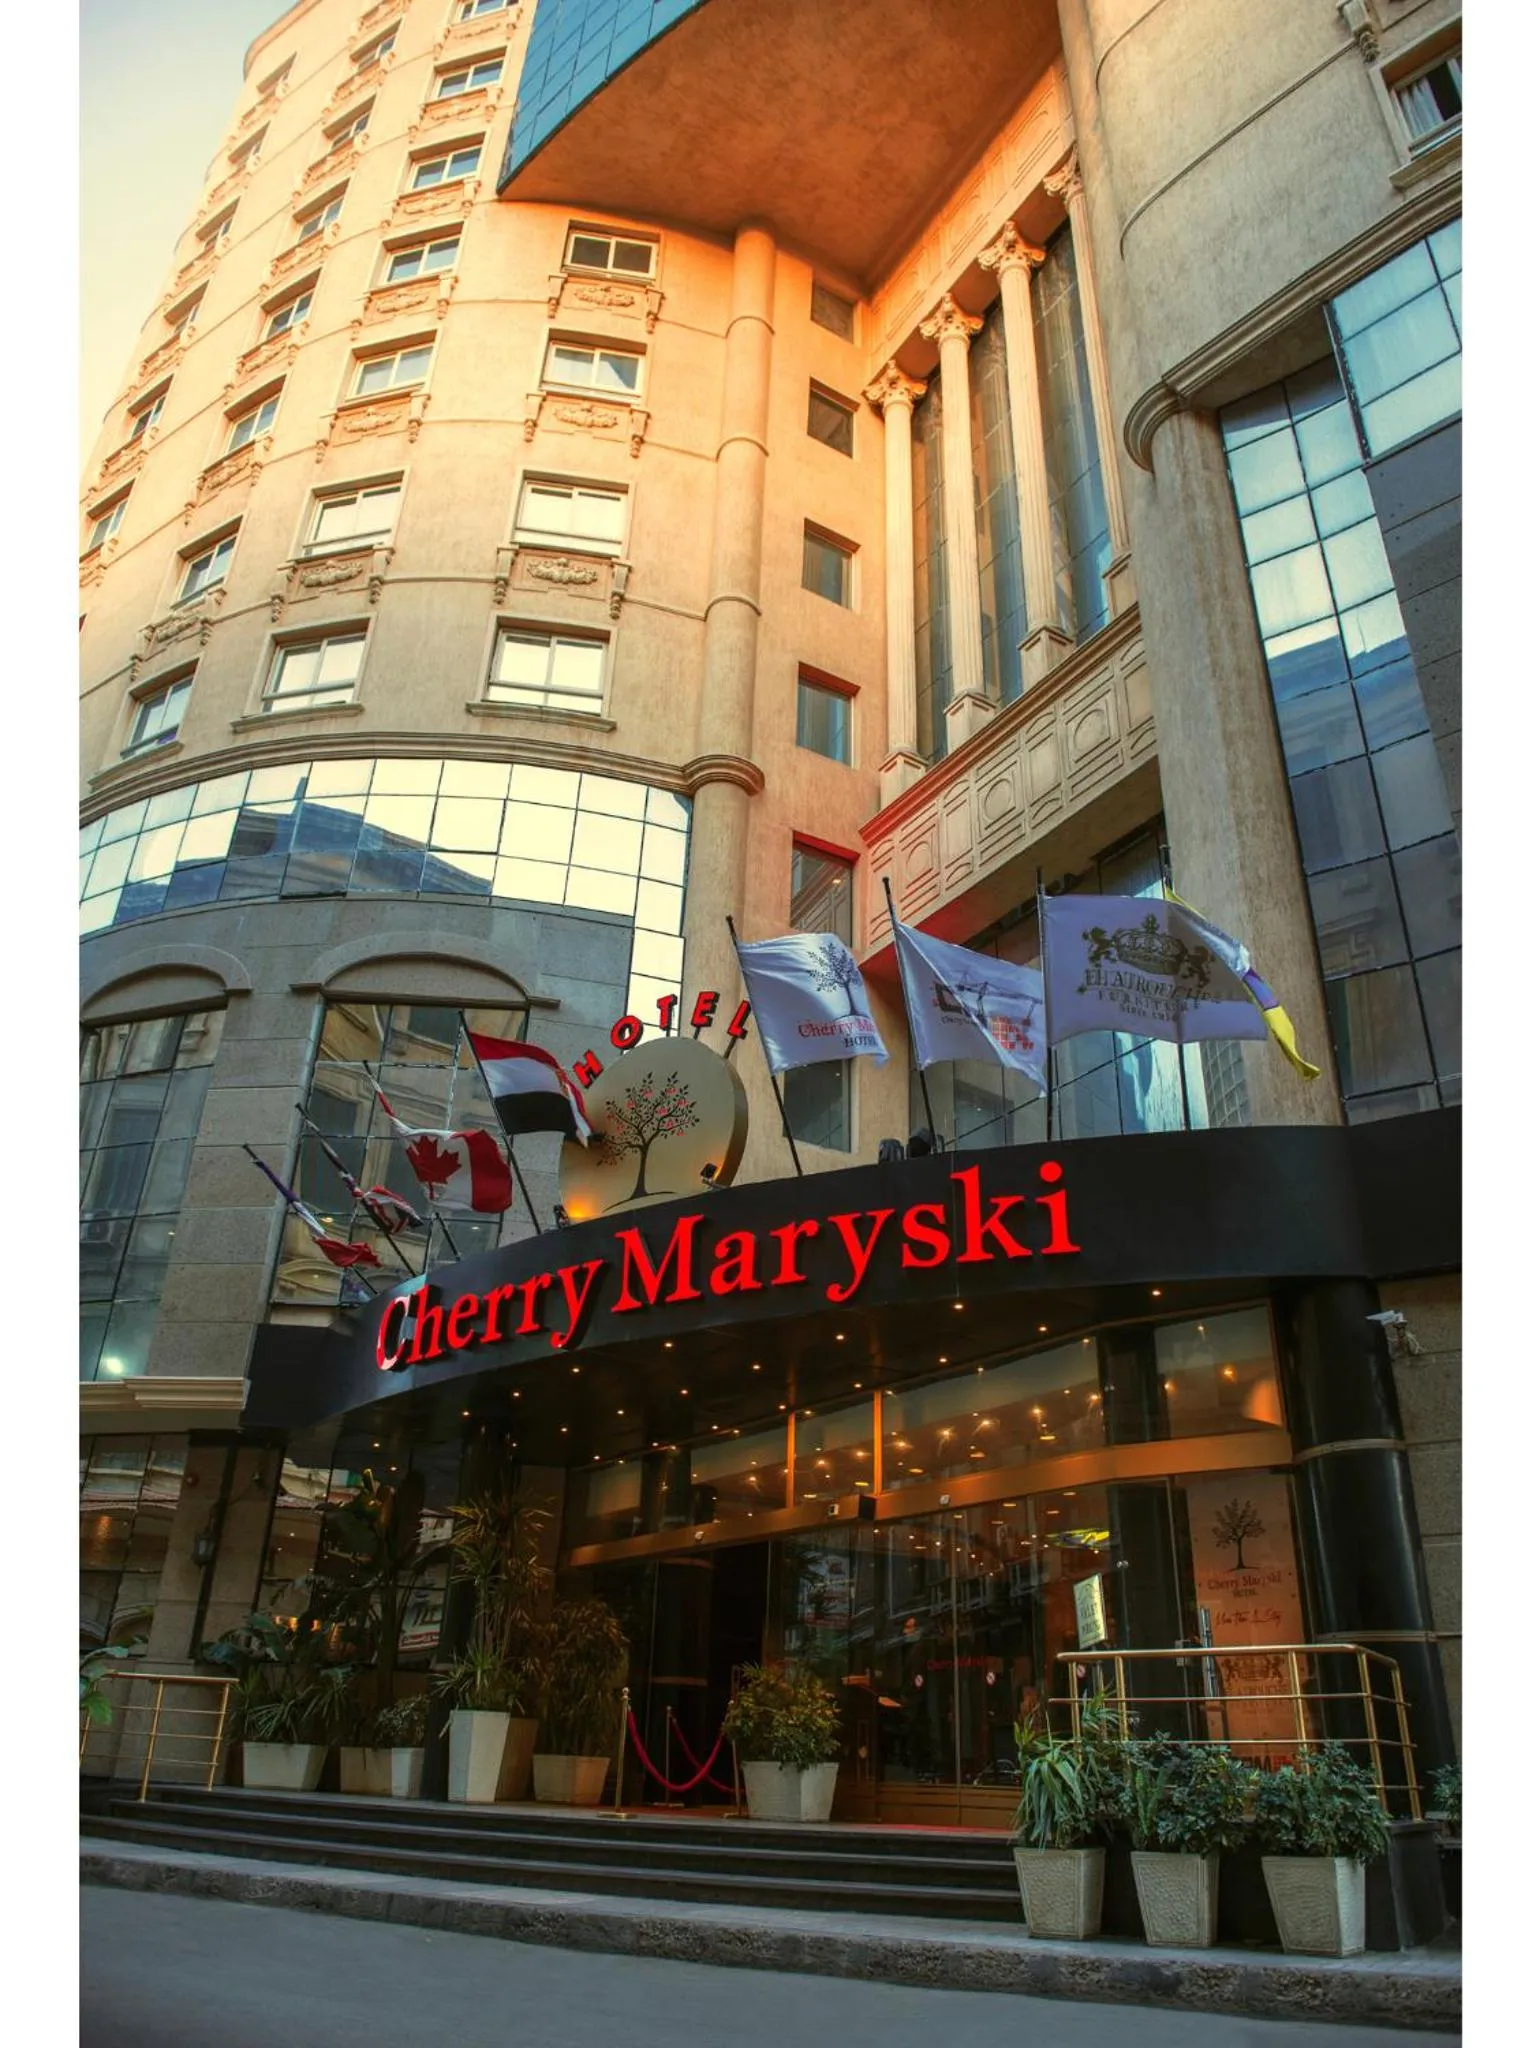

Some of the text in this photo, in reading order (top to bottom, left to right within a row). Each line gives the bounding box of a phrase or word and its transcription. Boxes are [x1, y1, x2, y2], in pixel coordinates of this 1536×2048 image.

[573, 991, 751, 1089] HOTEL
[797, 1021, 854, 1038] Cherry
[374, 1162, 1081, 1371] Cherry Maryski
